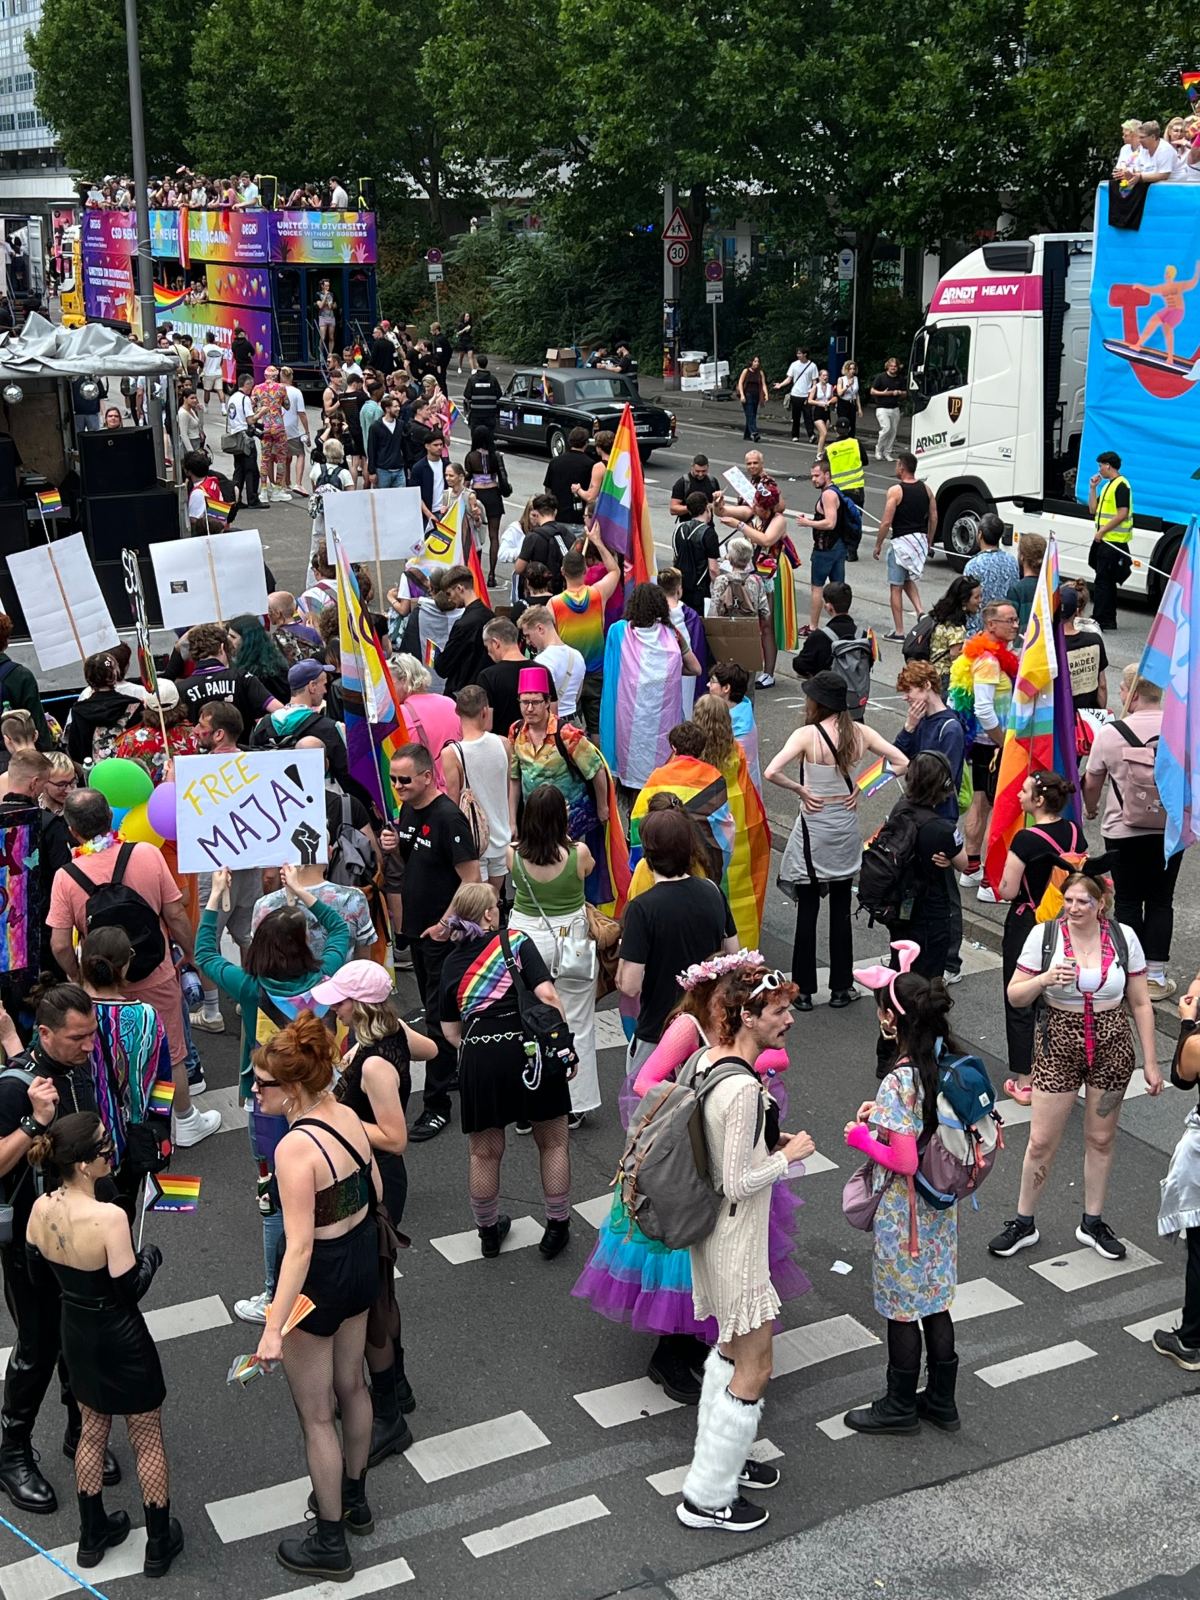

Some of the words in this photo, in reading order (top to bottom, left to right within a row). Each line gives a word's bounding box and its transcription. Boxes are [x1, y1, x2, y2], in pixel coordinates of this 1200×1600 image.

[671, 247, 684, 259] 30
[939, 286, 978, 305] ARNDT
[981, 284, 1020, 296] HEAVY
[915, 431, 948, 454] ARNDT
[186, 685, 206, 702] ST.
[205, 680, 236, 696] PAULI
[183, 753, 260, 816] FREE
[197, 763, 314, 867] MAJA!
